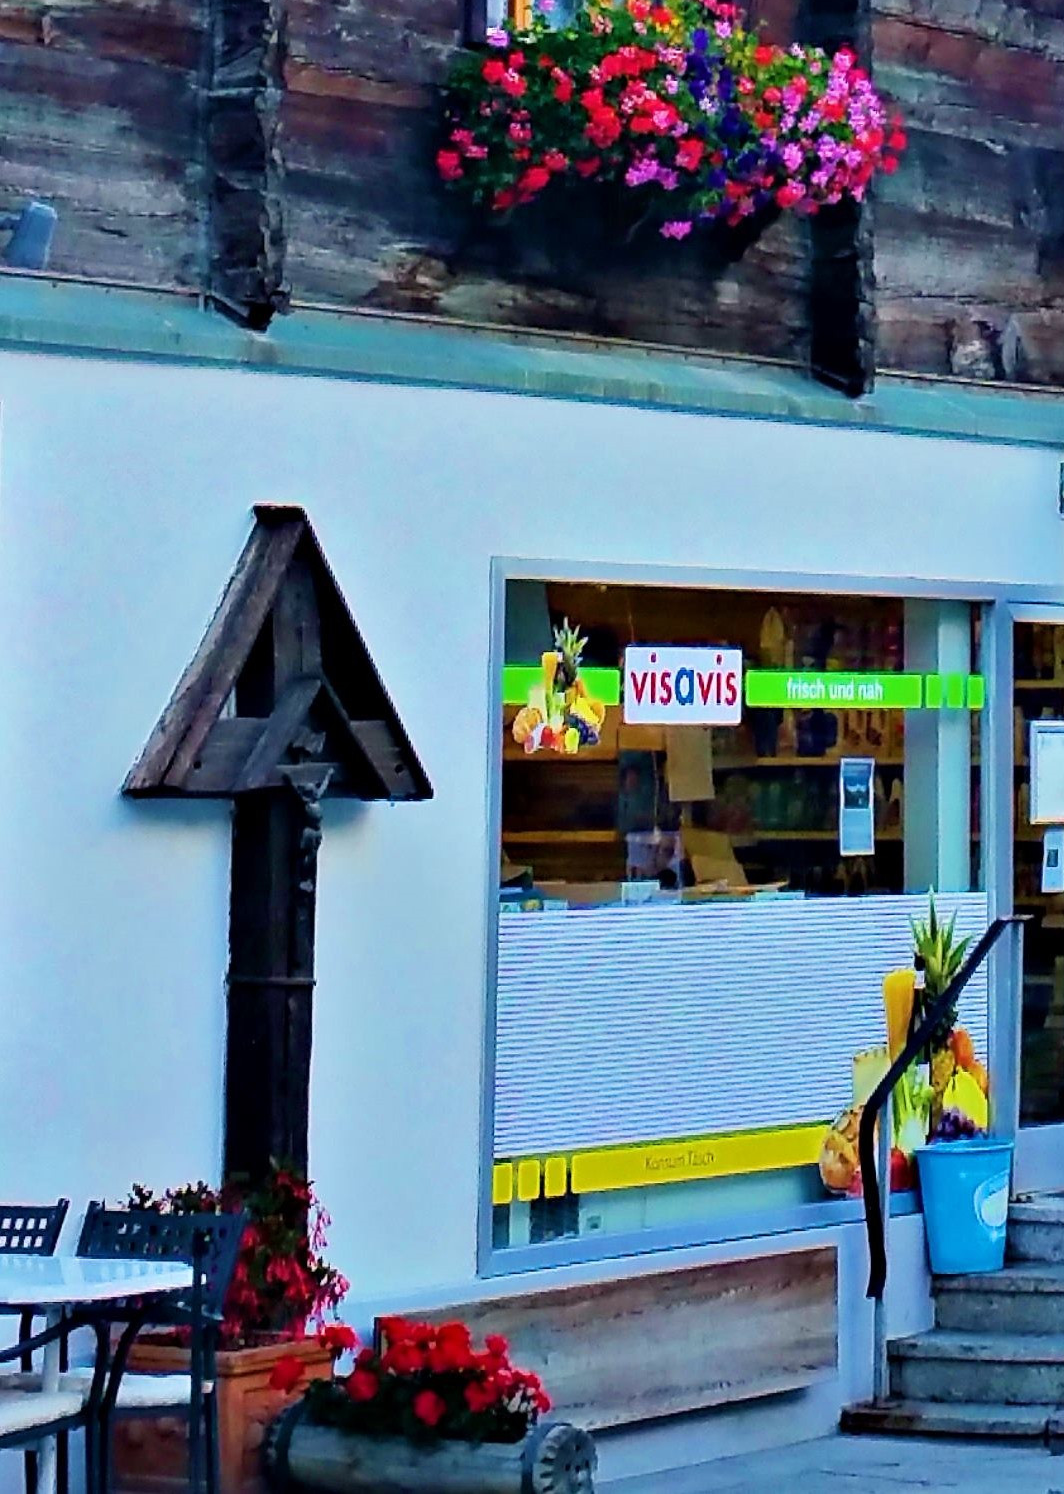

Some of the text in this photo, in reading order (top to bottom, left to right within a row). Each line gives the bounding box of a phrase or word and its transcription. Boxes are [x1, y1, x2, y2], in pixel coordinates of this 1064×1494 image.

[630, 652, 737, 706] visavis
[787, 676, 884, 701] frisch und nah
